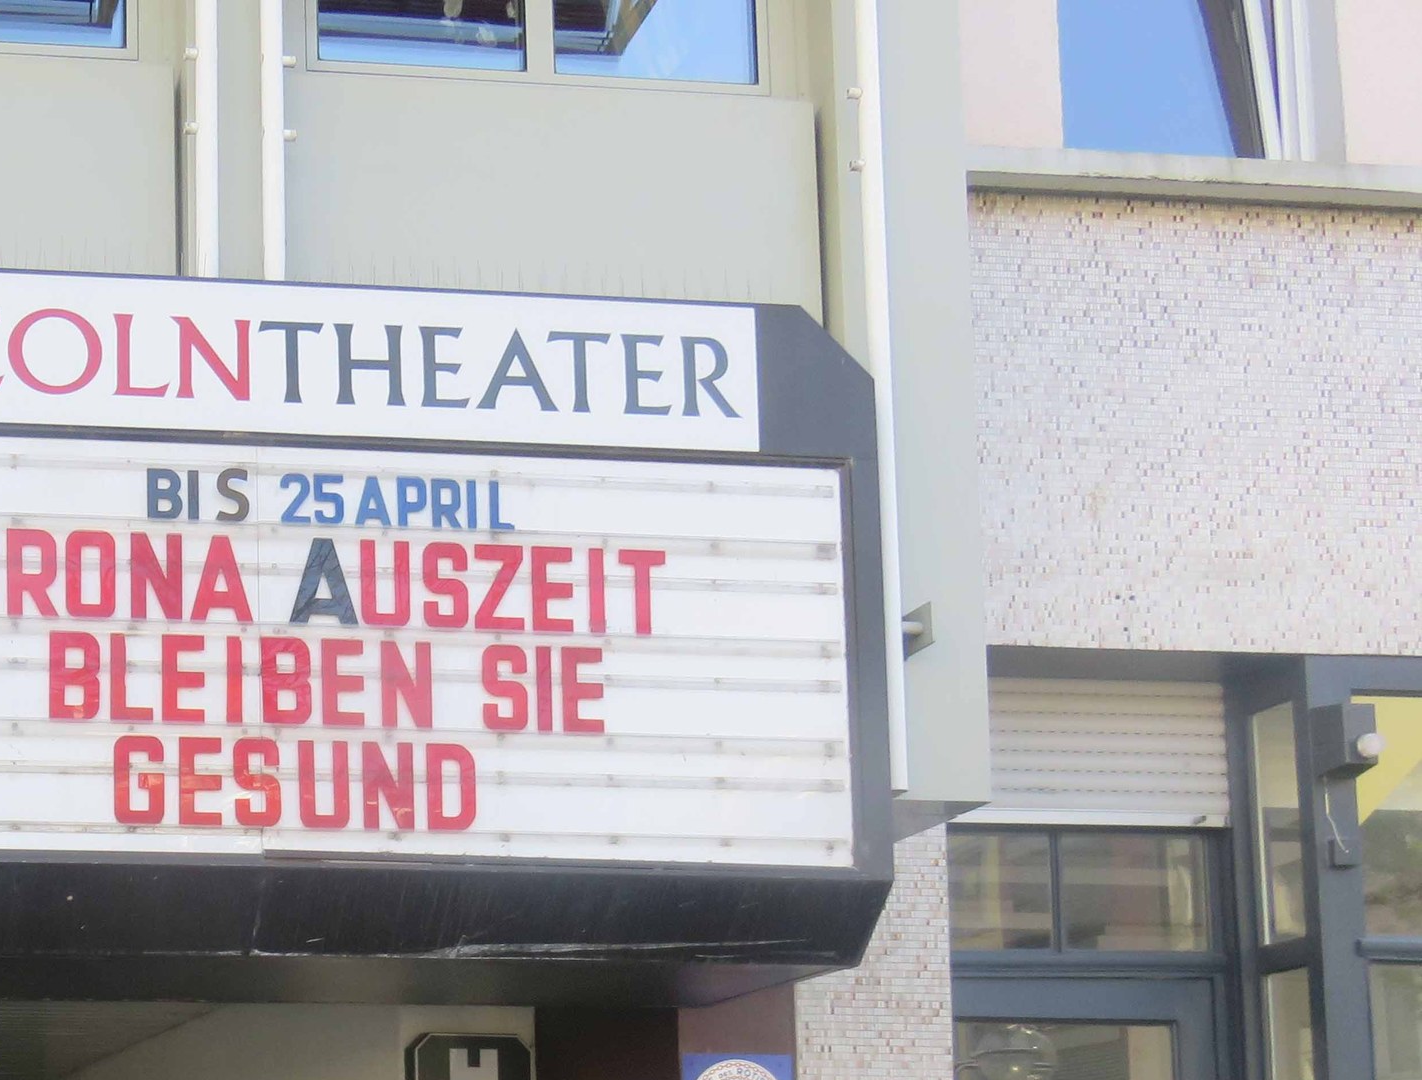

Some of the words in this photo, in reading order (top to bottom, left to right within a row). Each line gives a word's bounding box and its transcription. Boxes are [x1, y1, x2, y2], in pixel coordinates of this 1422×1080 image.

[146, 467, 250, 523] BIS
[280, 472, 345, 526] 25
[356, 475, 515, 531] APRIL
[289, 536, 666, 636] AUSZEIT
[48, 629, 433, 729] BLEIBEN
[481, 643, 604, 735] SIE
[113, 734, 477, 831] GESUND
